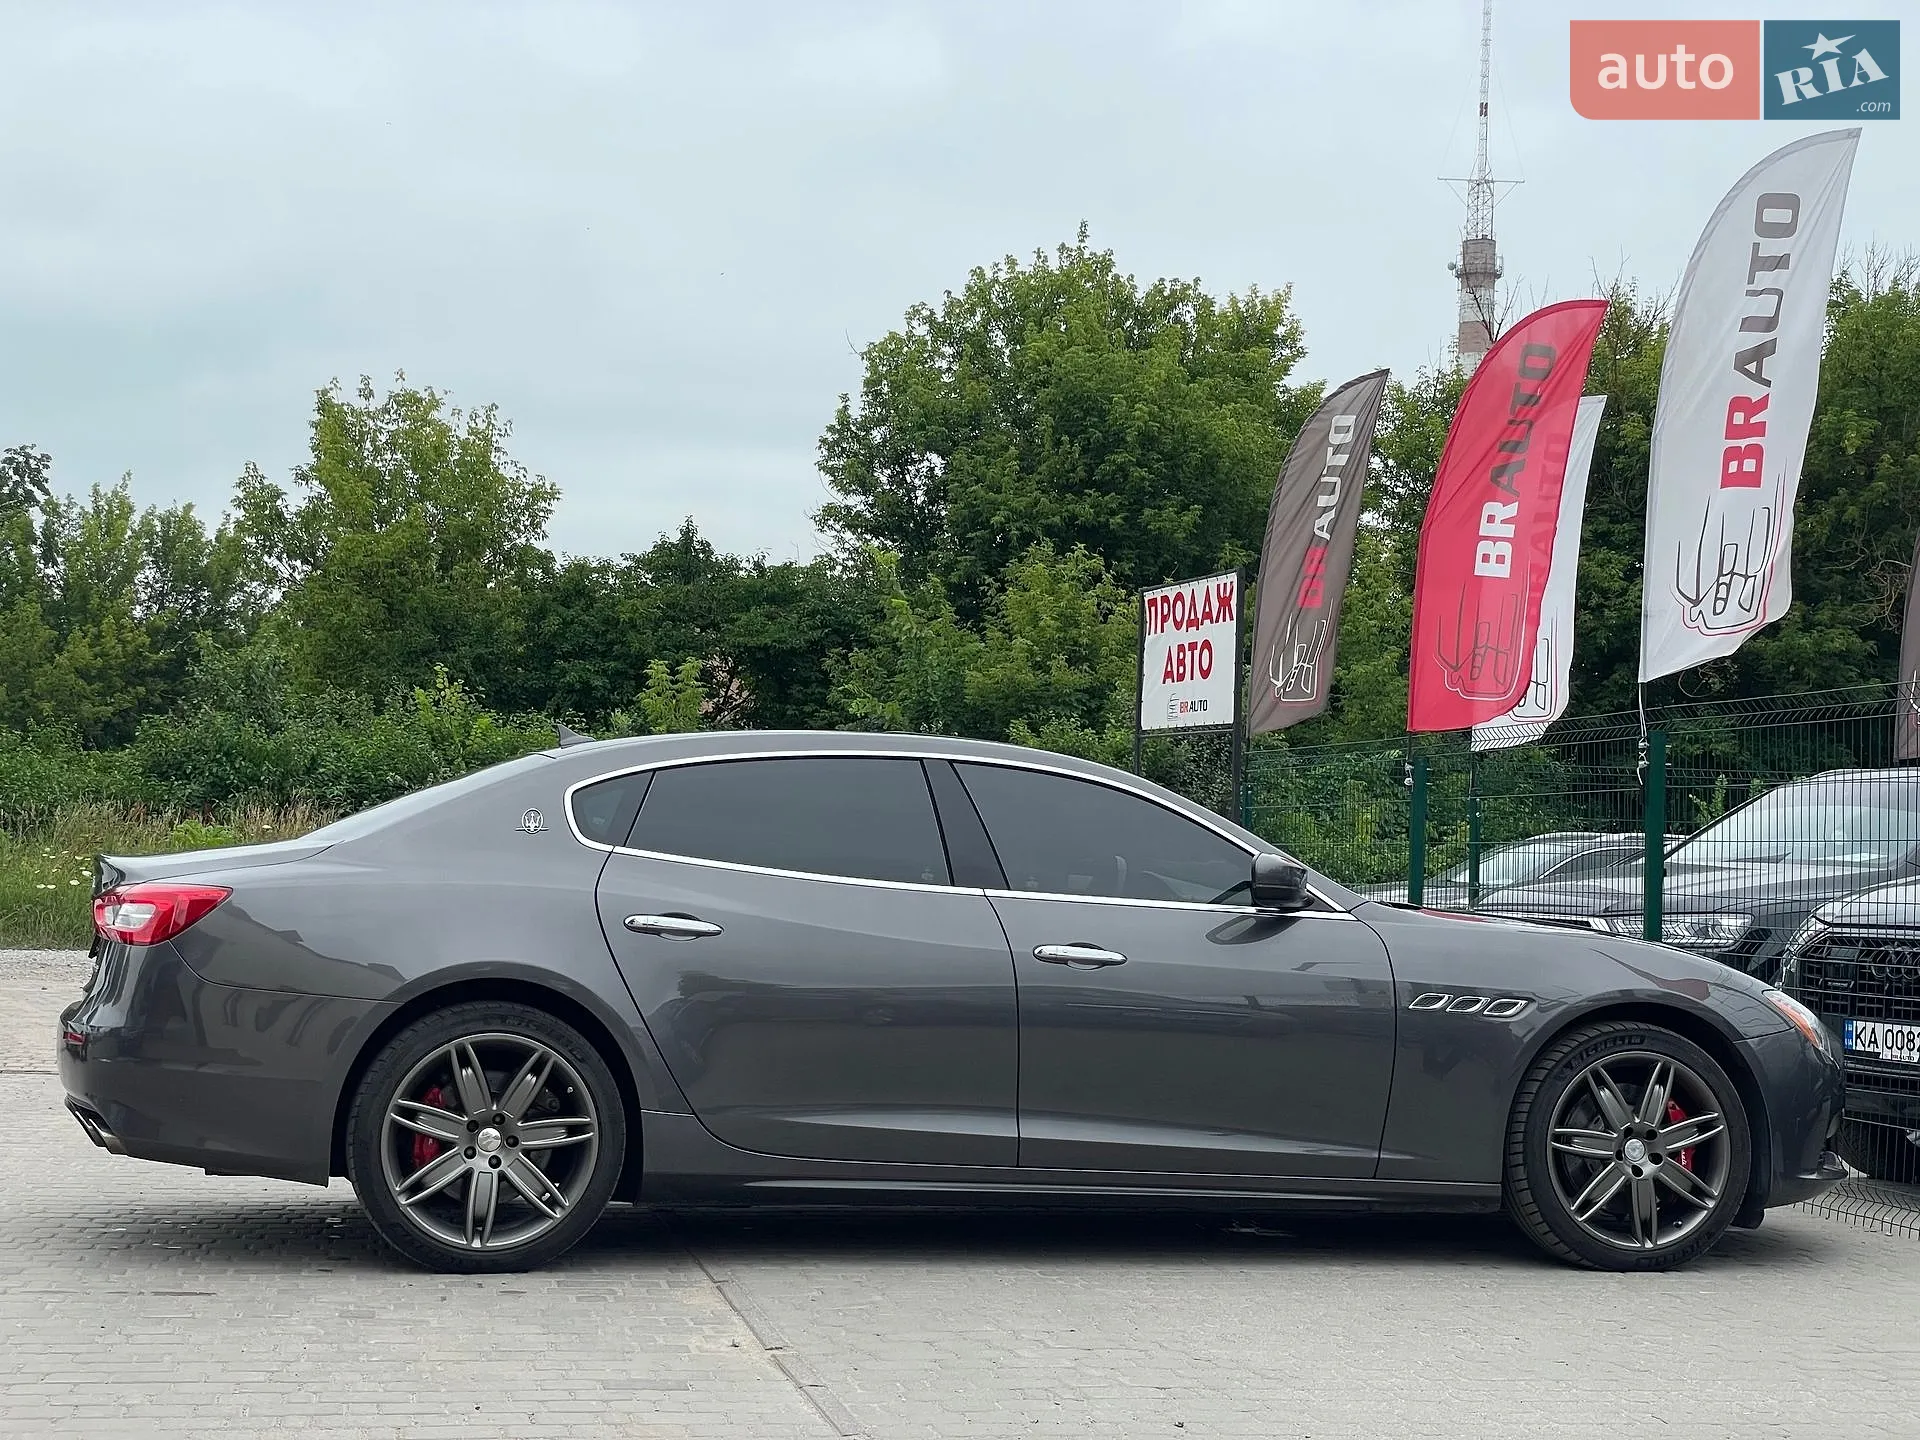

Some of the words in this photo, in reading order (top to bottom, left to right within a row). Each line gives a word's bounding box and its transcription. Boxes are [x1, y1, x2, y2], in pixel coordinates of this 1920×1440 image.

[1719, 192, 1801, 490] BRAUTO
[1473, 341, 1557, 579] BRAUTO
[1147, 580, 1235, 636] ПРОДАЖ
[1162, 638, 1213, 685] АВТО
[1855, 1026, 1879, 1049] KA
